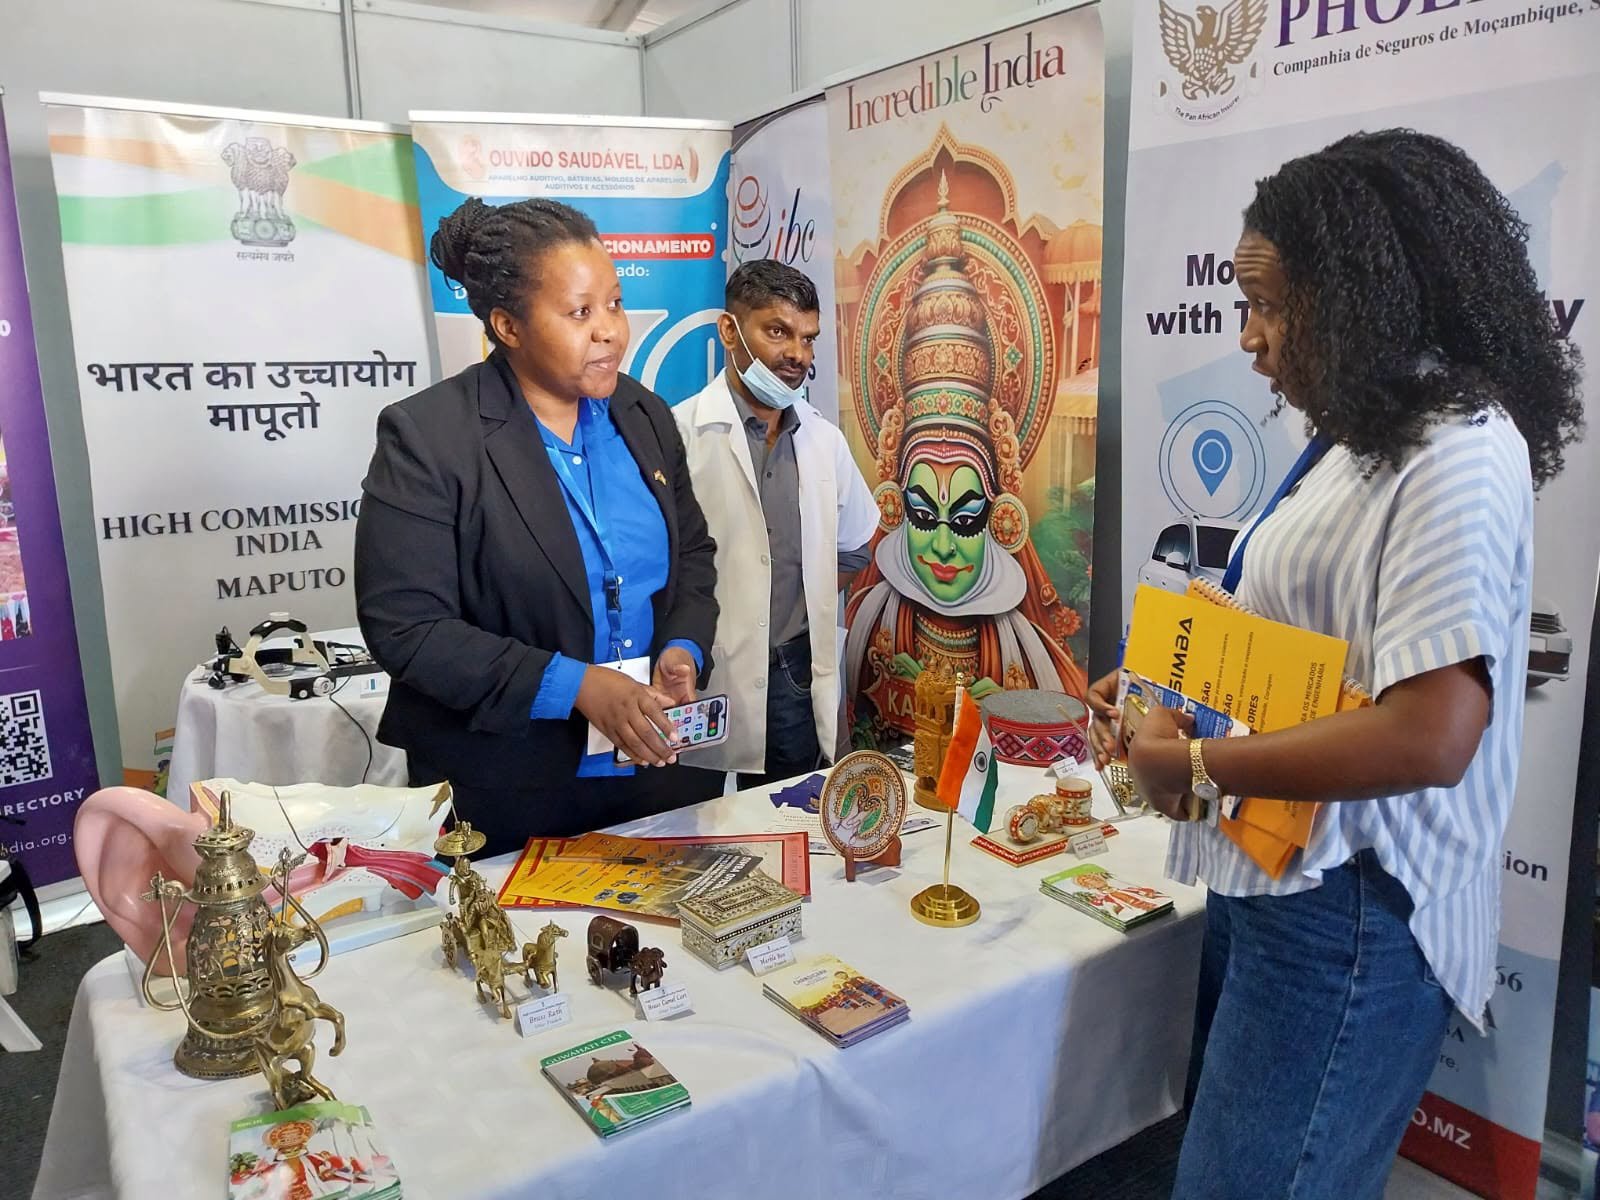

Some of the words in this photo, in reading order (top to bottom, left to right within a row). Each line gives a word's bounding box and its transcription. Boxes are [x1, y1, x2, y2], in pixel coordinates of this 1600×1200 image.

[1273, 49, 1350, 76] Companhia
[1355, 44, 1371, 60] de
[1375, 32, 1435, 55] Seguros
[1439, 25, 1458, 42] de
[1463, 2, 1583, 37] Moçambique,
[847, 55, 977, 131] Incredible
[981, 32, 1066, 113] India
[489, 150, 553, 167] OUVIDO
[558, 148, 648, 172] SAUDÁVEL,
[653, 154, 684, 170] LDA
[603, 239, 711, 254] CIONAMENTO
[616, 263, 650, 277] ado:
[1185, 253, 1236, 287] Mo
[1146, 302, 1222, 335] with
[86, 361, 193, 392] भारत
[203, 361, 256, 390] का
[266, 351, 417, 390] उच्चायोग
[207, 391, 321, 441] मापूतो
[101, 511, 193, 540] HIGH
[235, 529, 323, 557] INDIA
[216, 567, 346, 600] MAPUTO
[1168, 617, 1193, 693] SIMBA
[1200, 681, 1212, 706] SÃO
[1305, 662, 1317, 701] MERCADOS
[1311, 663, 1325, 709] ENGENHARIA
[1222, 693, 1233, 716] SÃO
[1247, 694, 1260, 727] ORES
[0, 787, 85, 816] RECTORY
[546, 1042, 600, 1065] GUWAHATI
[601, 1033, 622, 1045] CITY
